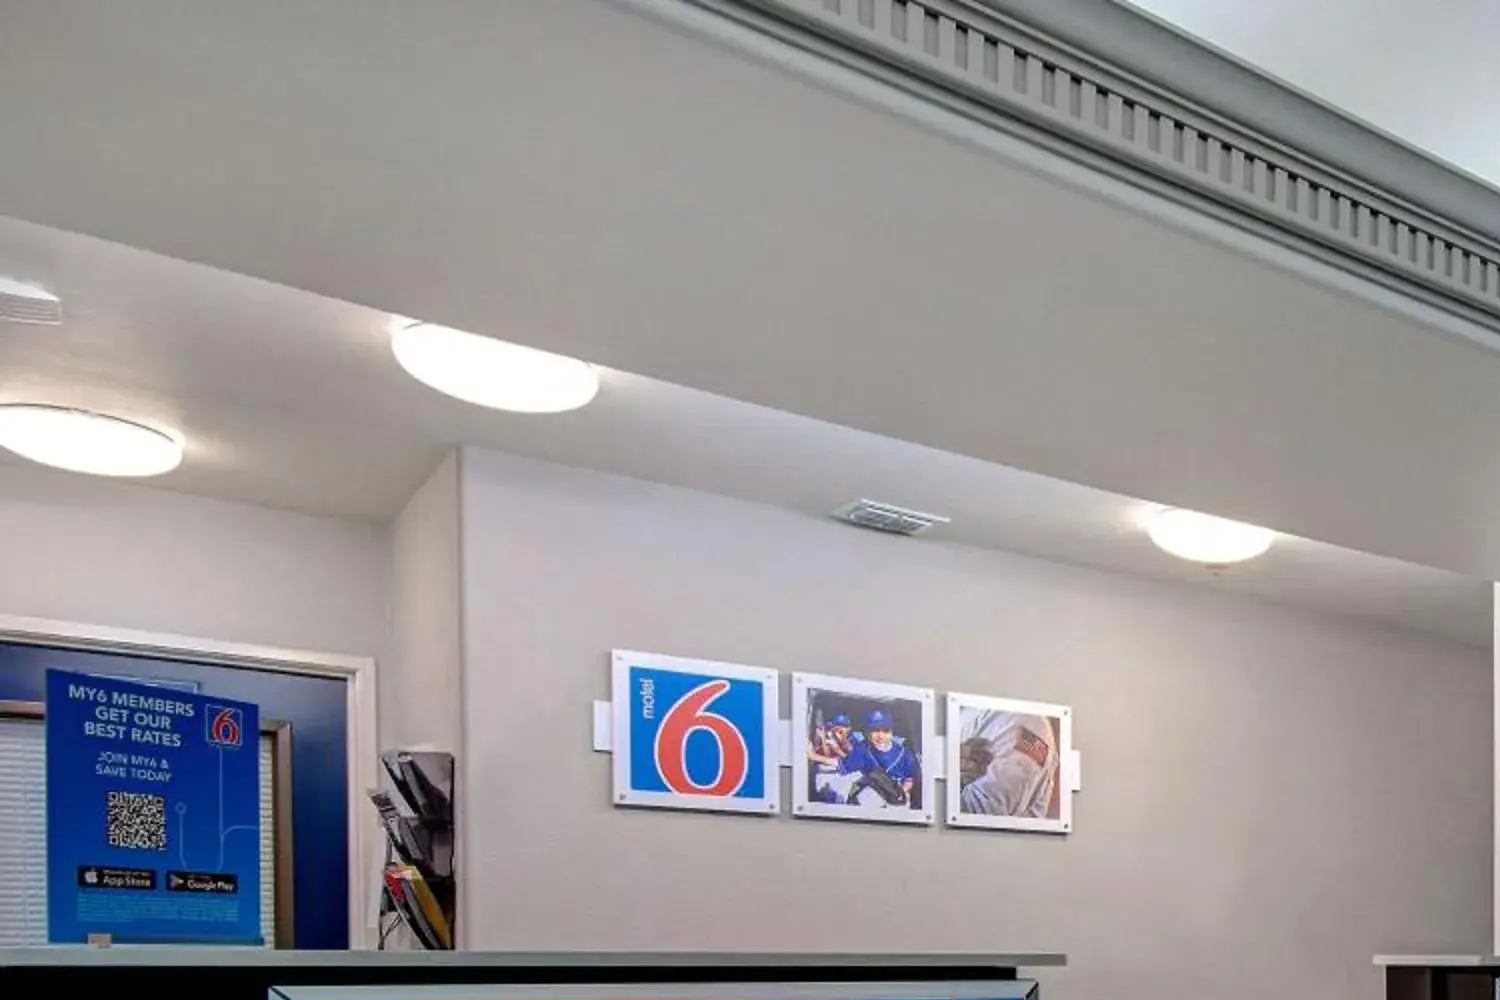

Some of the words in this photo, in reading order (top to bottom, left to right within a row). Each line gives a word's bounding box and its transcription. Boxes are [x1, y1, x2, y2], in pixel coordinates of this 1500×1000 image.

[68, 683, 107, 703] MY6
[112, 691, 195, 718] MEMBERS
[639, 677, 655, 719] motel
[95, 705, 130, 722] GET
[134, 711, 172, 730] OUR
[211, 706, 239, 744] 6
[84, 720, 126, 740] BEST
[131, 727, 182, 748] RATES
[654, 679, 748, 798] 6
[95, 763, 126, 778] SAVE
[131, 767, 173, 783] TODAY
[97, 750, 128, 766] JOIN
[131, 753, 157, 768] MY6
